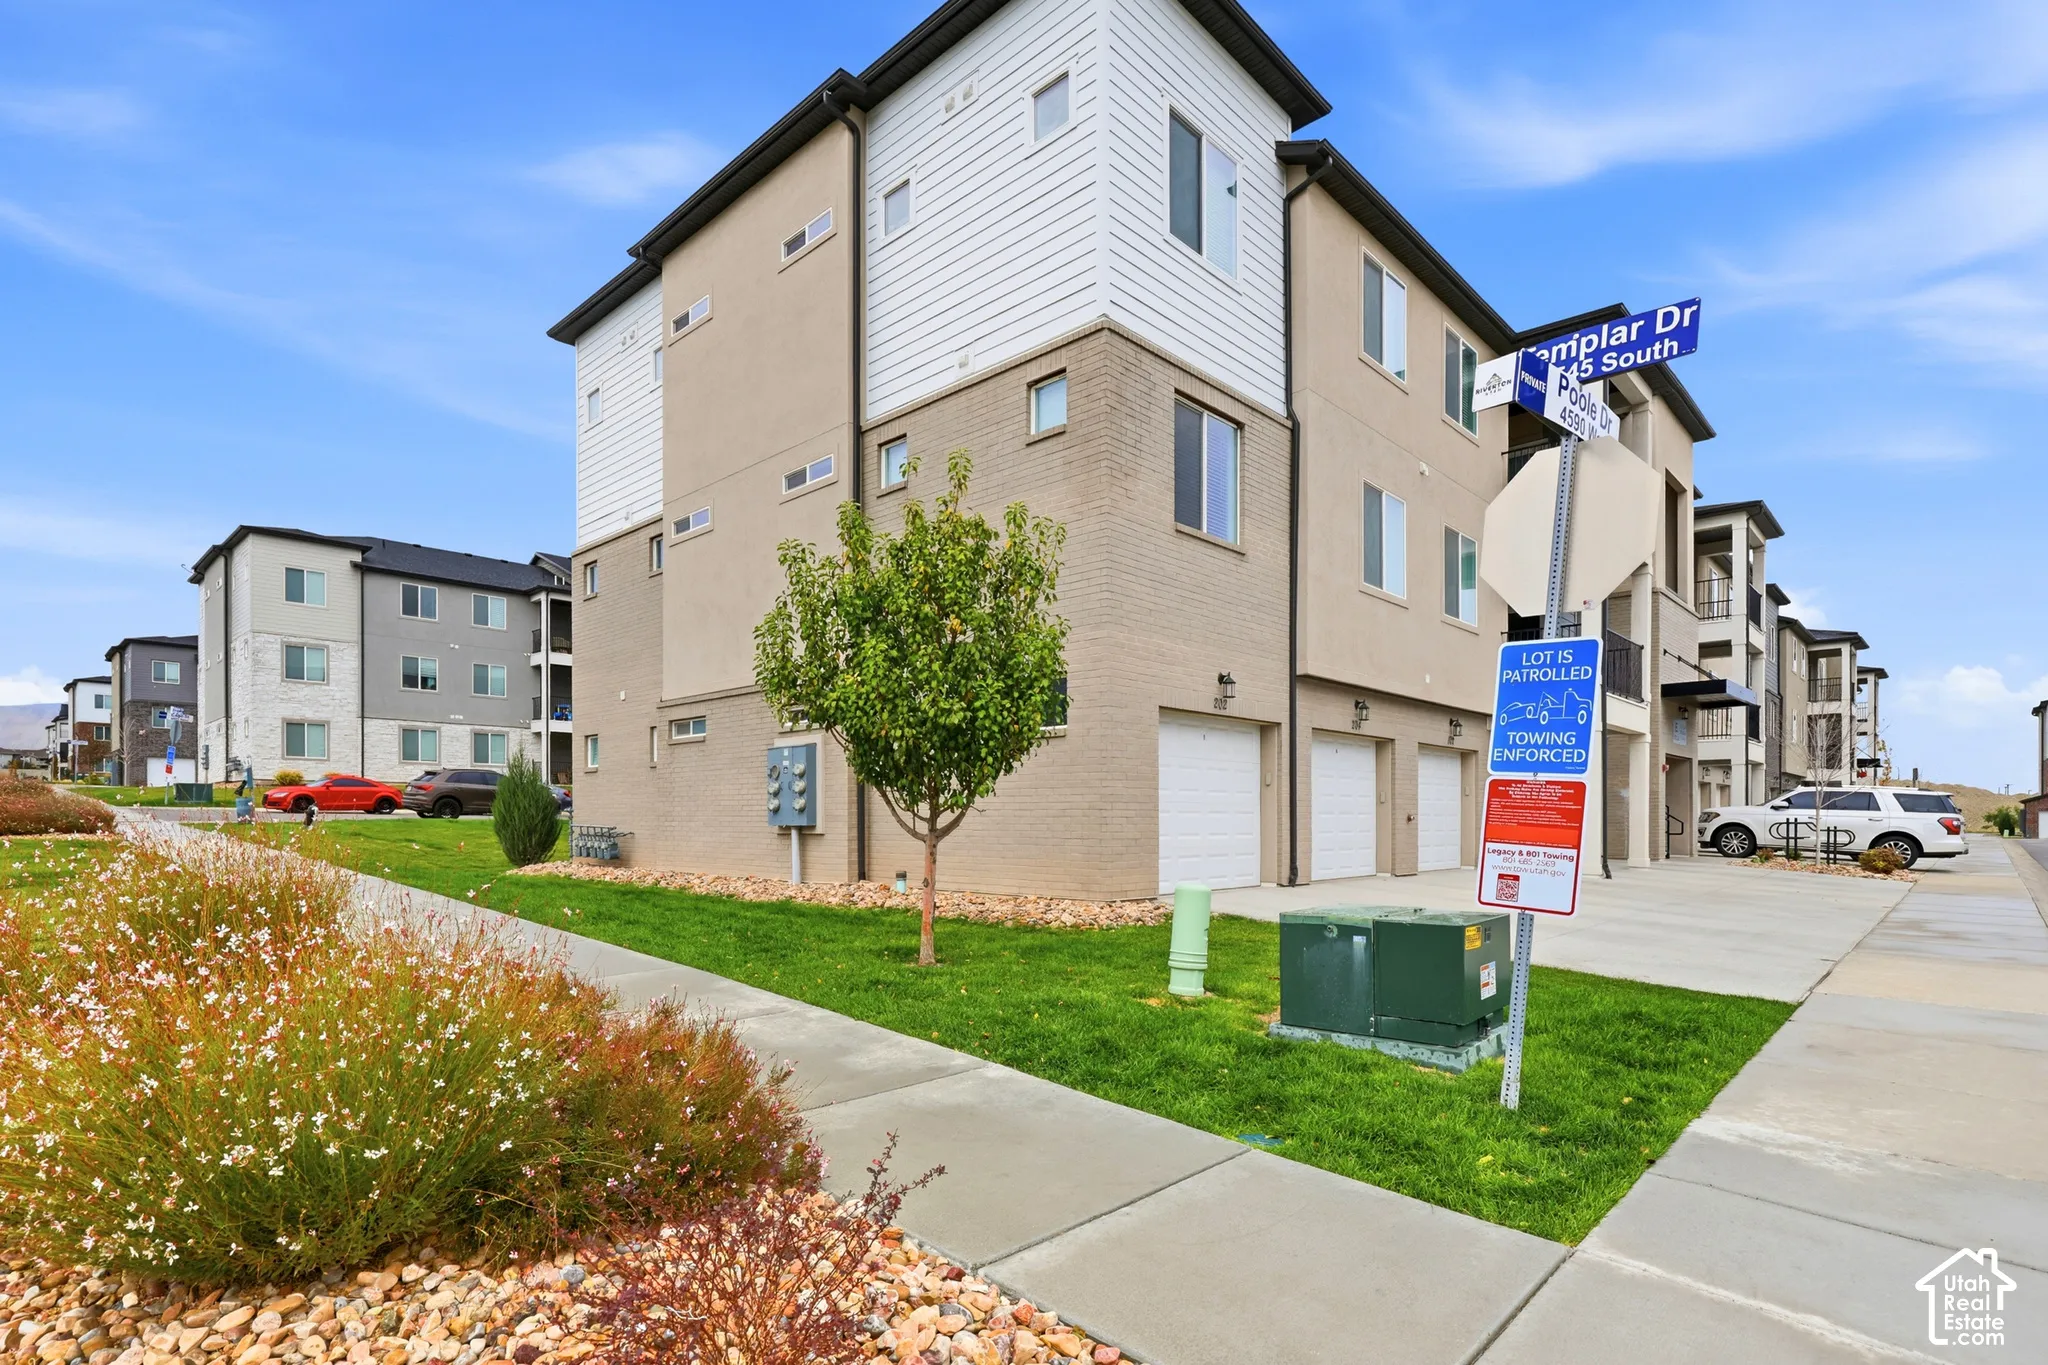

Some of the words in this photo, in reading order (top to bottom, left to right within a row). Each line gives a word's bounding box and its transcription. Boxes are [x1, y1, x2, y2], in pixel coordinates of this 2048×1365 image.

[1655, 305, 1698, 335] Dr
[1601, 338, 1679, 373] South
[1521, 370, 1547, 394] PRIVATE
[1558, 372, 1597, 421] Poole
[1600, 404, 1613, 435] Dr
[1560, 406, 1586, 436] 4590
[1522, 650, 1554, 666] LOT
[1558, 649, 1573, 664] IS
[1502, 665, 1593, 683] PATROLLED
[1507, 731, 1577, 746] TOWING
[1493, 748, 1586, 763] ENFORCED
[1487, 847, 1516, 857] Legacy
[1518, 849, 1524, 857] &
[1526, 850, 1540, 858] 801
[1543, 851, 1575, 862] Towing
